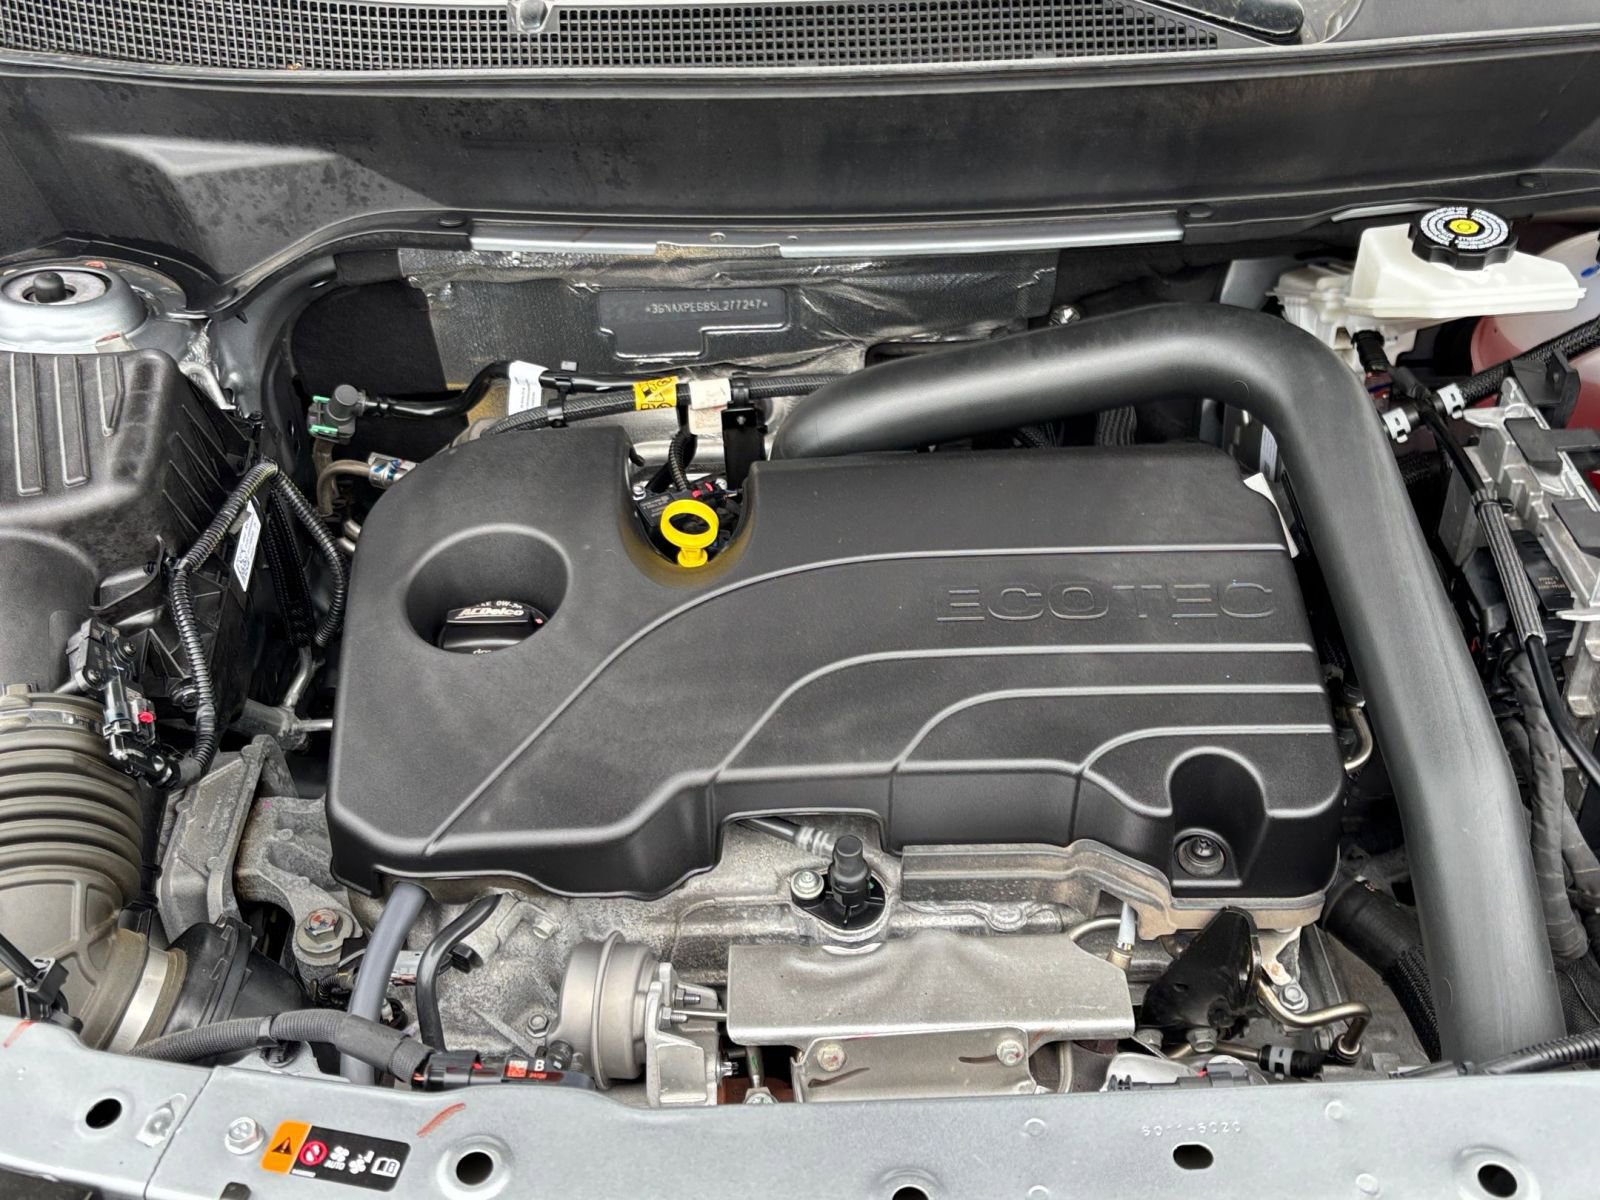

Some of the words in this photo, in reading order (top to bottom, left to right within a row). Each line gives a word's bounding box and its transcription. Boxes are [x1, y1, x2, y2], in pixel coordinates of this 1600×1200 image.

[936, 581, 1275, 621] ECOTEC
[456, 607, 524, 619] ACDelco
[534, 1059, 545, 1072] B
[323, 1160, 346, 1171] AUTO
